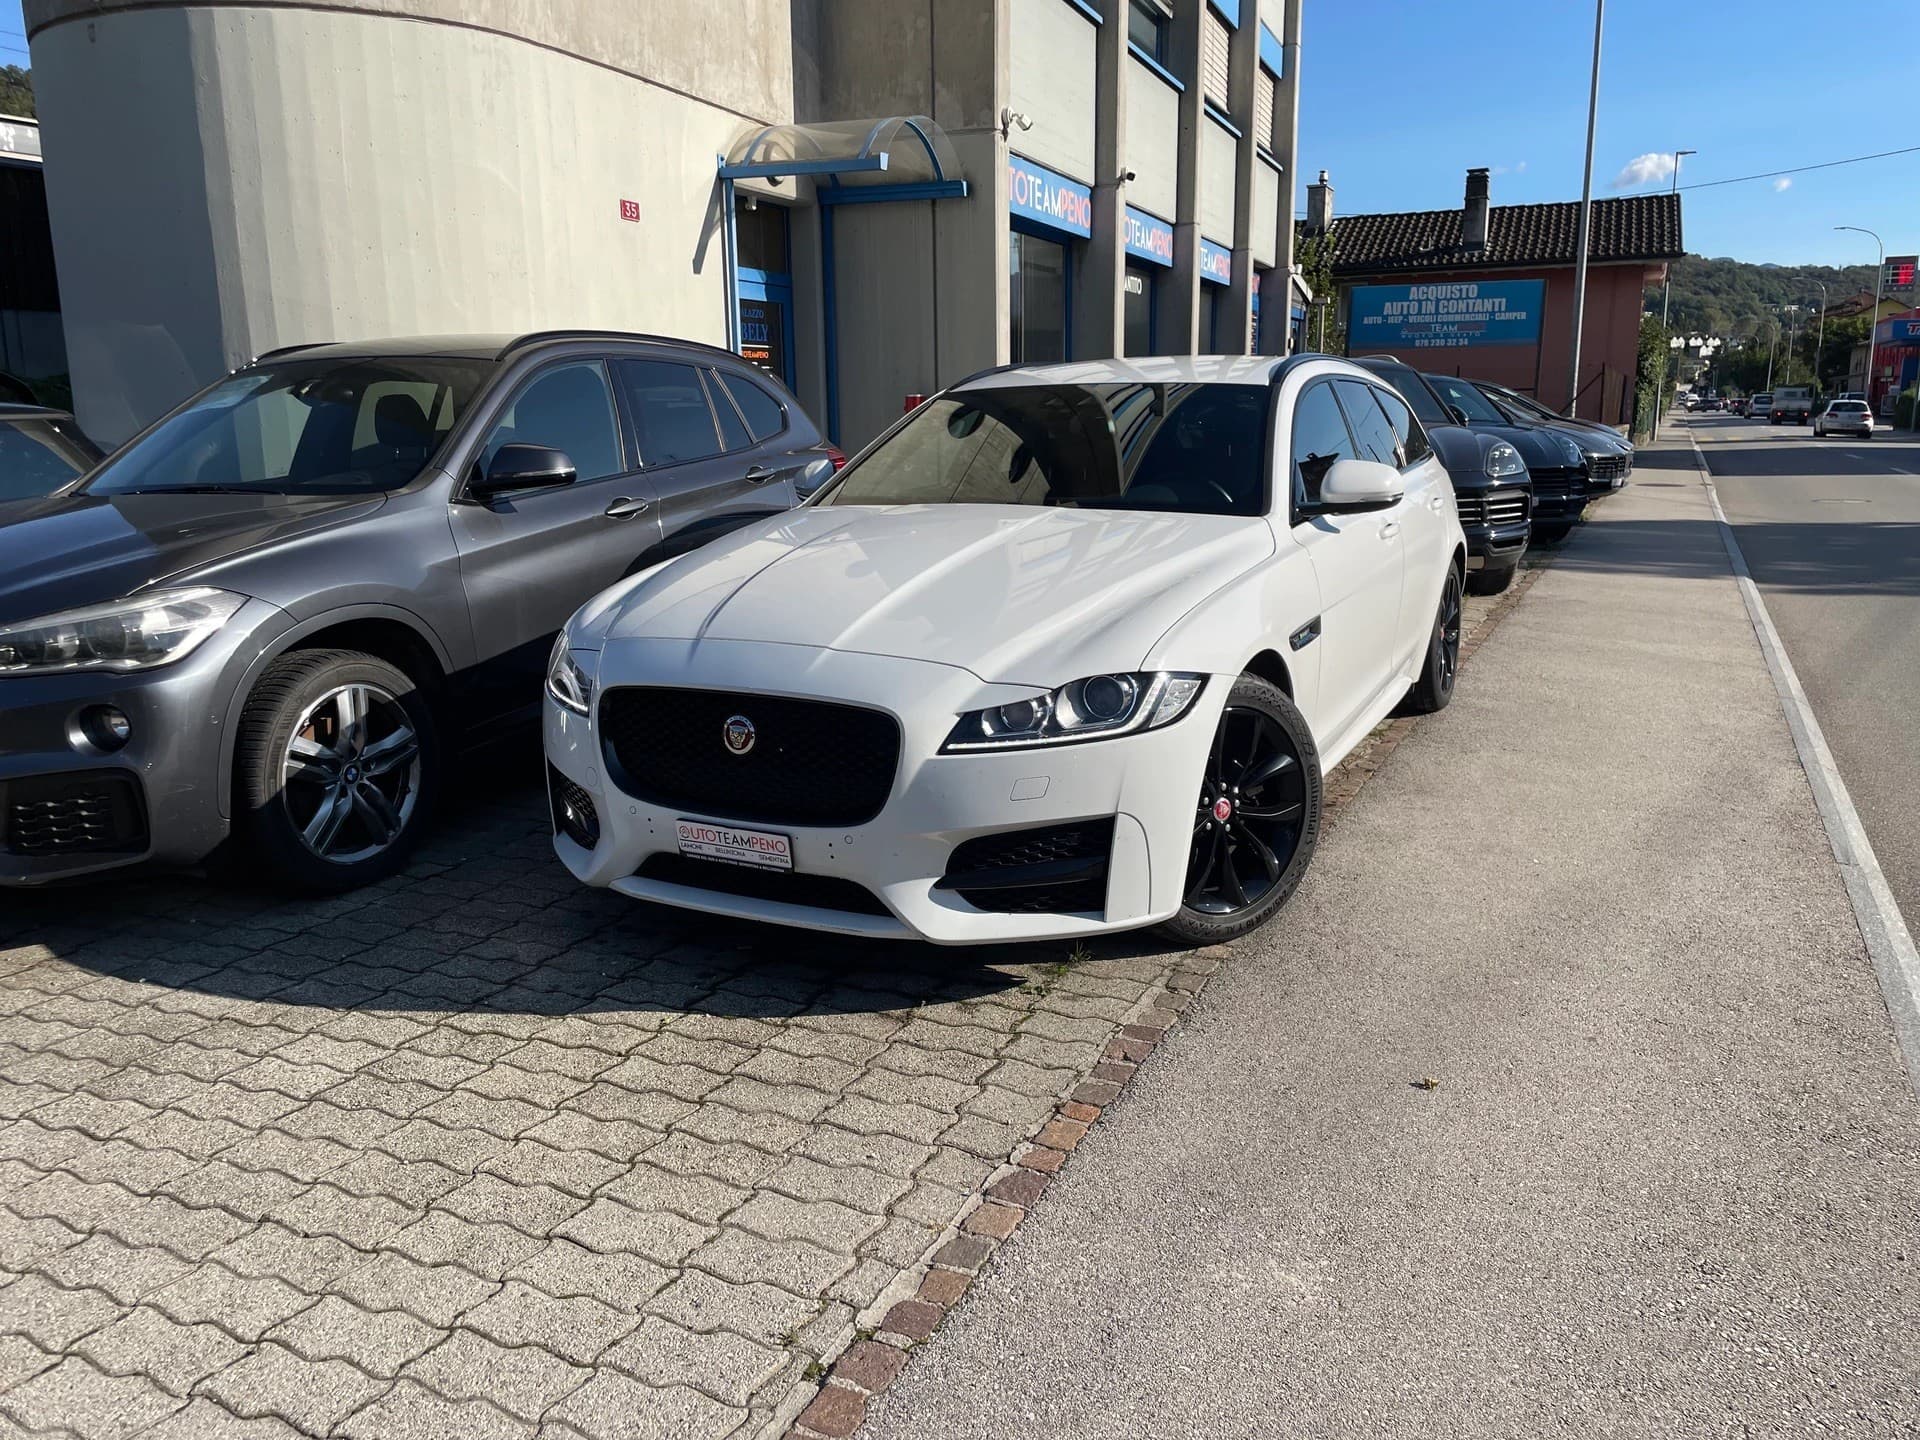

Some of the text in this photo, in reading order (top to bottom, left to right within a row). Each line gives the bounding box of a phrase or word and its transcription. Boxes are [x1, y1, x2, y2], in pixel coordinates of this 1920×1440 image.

[624, 202, 637, 217] 35
[1409, 284, 1478, 300] ACQUISTO
[1383, 297, 1506, 315] AUTO IN CONTANTI
[1363, 315, 1382, 325] AUTO
[1387, 315, 1404, 325] JEEP
[1408, 314, 1436, 324] VEICOLI
[1495, 311, 1527, 321] CAMPER
